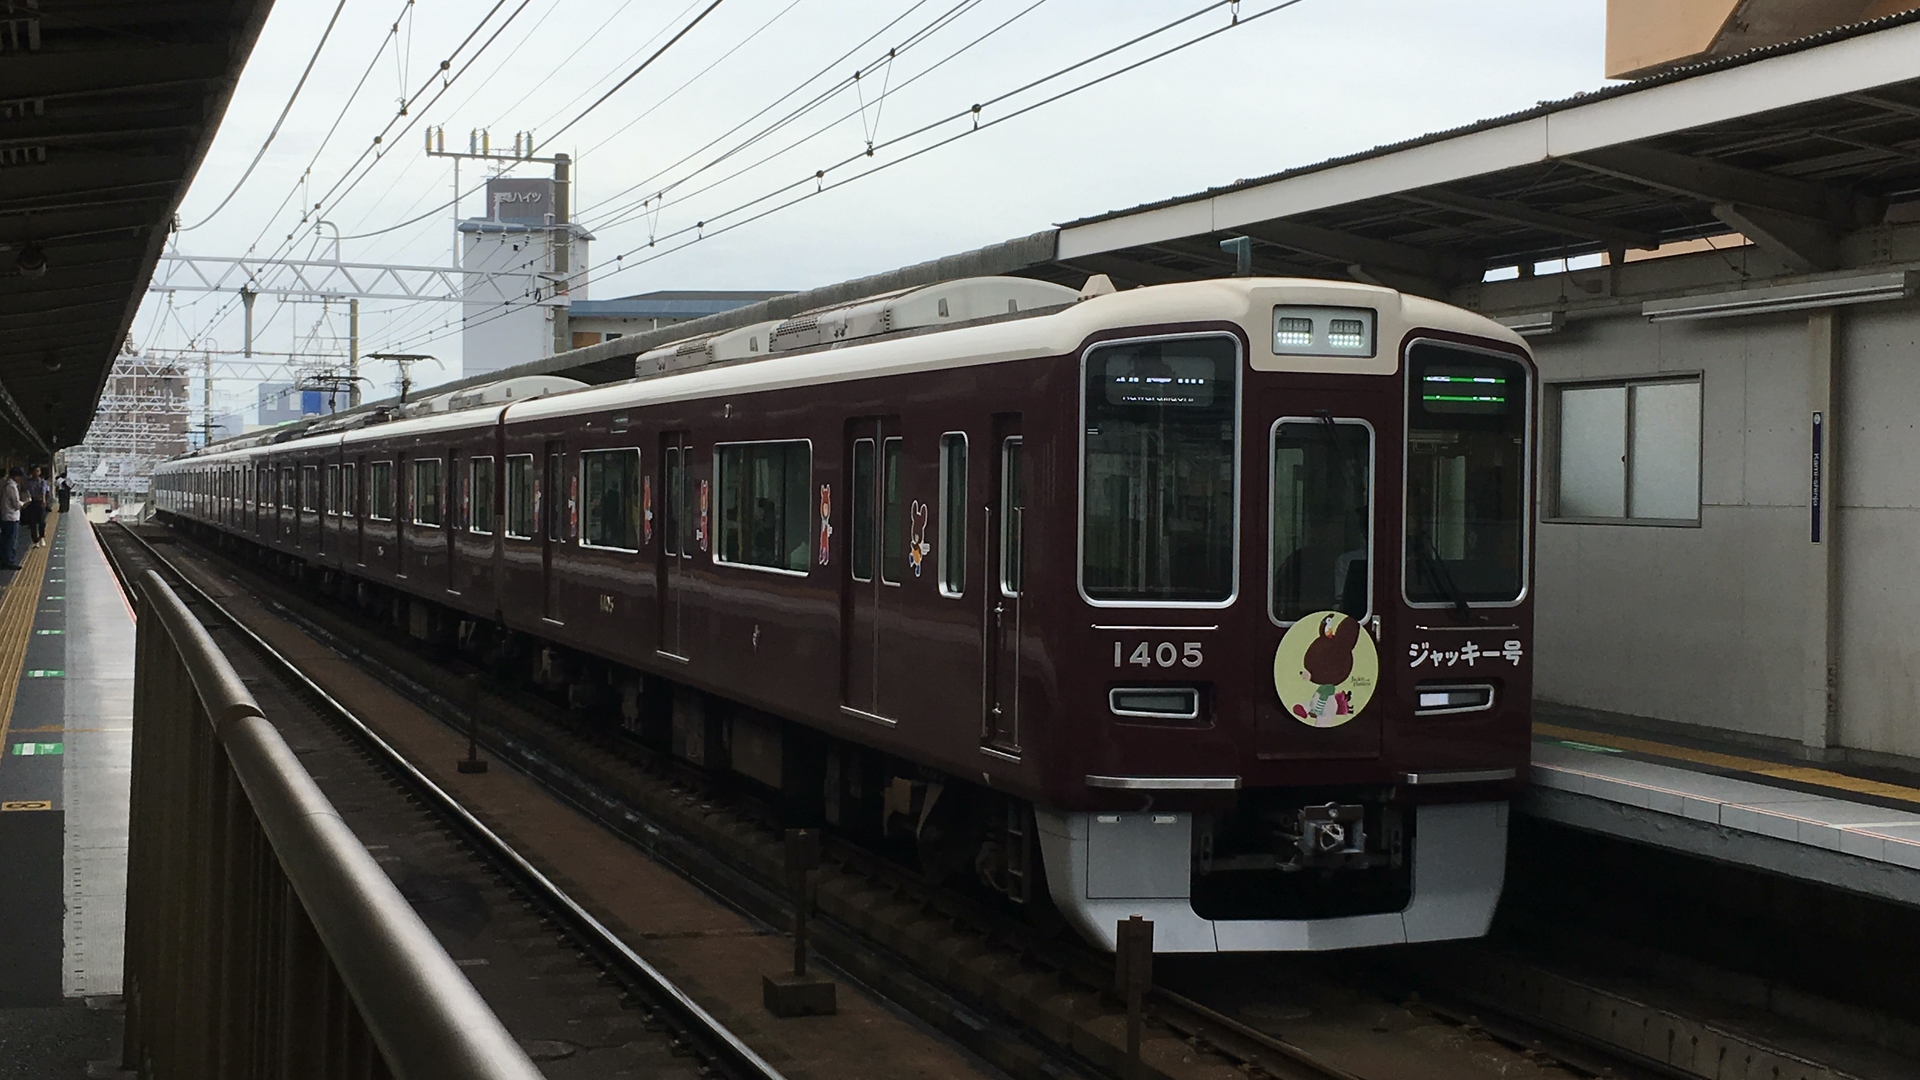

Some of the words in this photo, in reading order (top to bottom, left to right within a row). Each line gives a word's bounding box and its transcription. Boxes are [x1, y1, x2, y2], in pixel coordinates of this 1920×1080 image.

[1114, 641, 1204, 668] 1405
[1409, 640, 1523, 668] ジャッキー号
